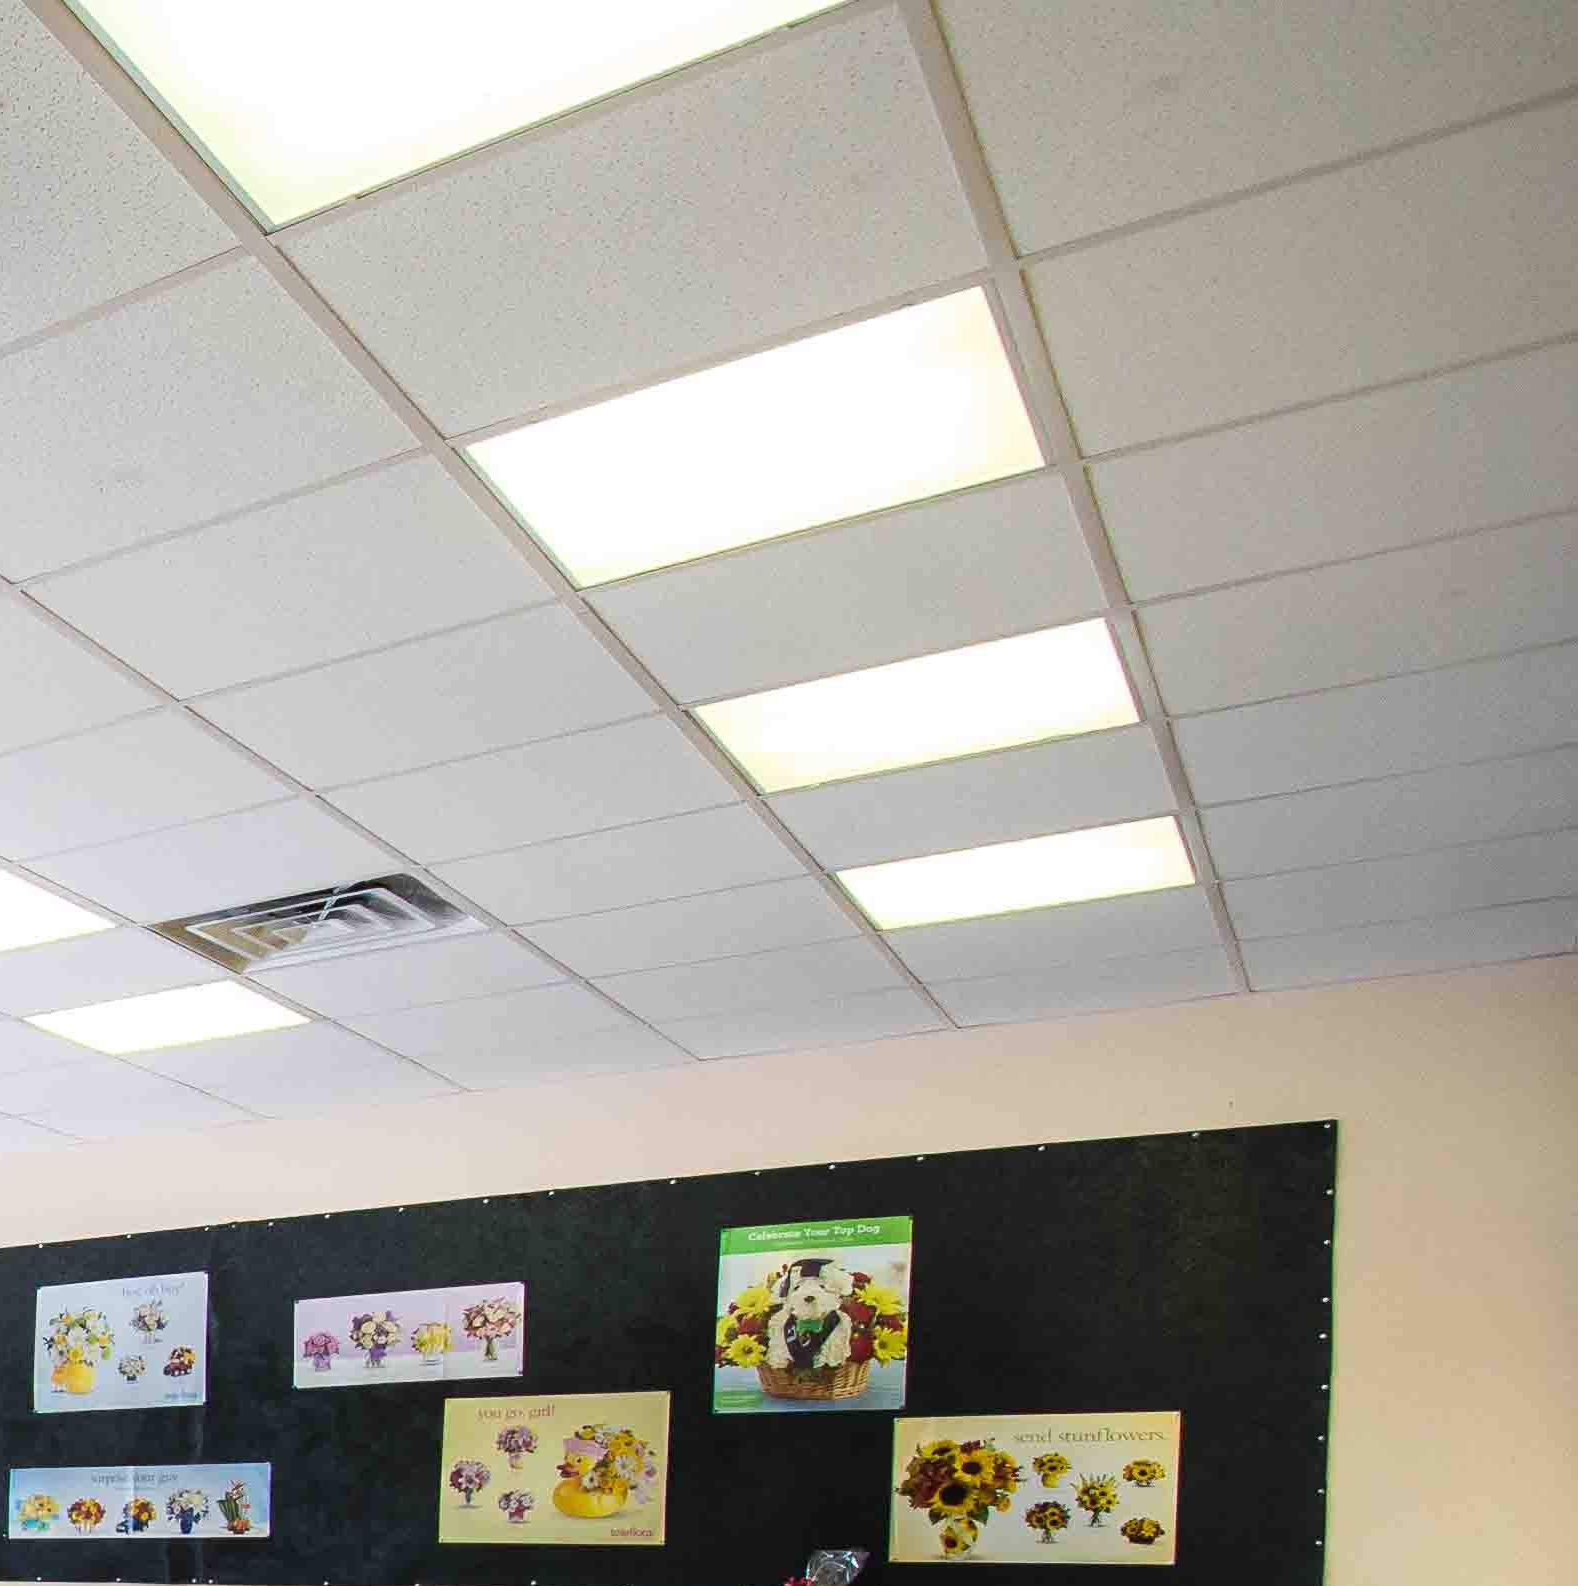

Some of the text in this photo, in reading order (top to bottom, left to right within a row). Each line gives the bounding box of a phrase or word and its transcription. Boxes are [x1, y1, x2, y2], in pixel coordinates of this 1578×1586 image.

[747, 1230, 801, 1241] Celebrate
[803, 1227, 829, 1237] Your
[834, 1225, 855, 1236] Top
[857, 1223, 881, 1235] Dog
[477, 1408, 501, 1421] you
[1012, 1426, 1052, 1442] send
